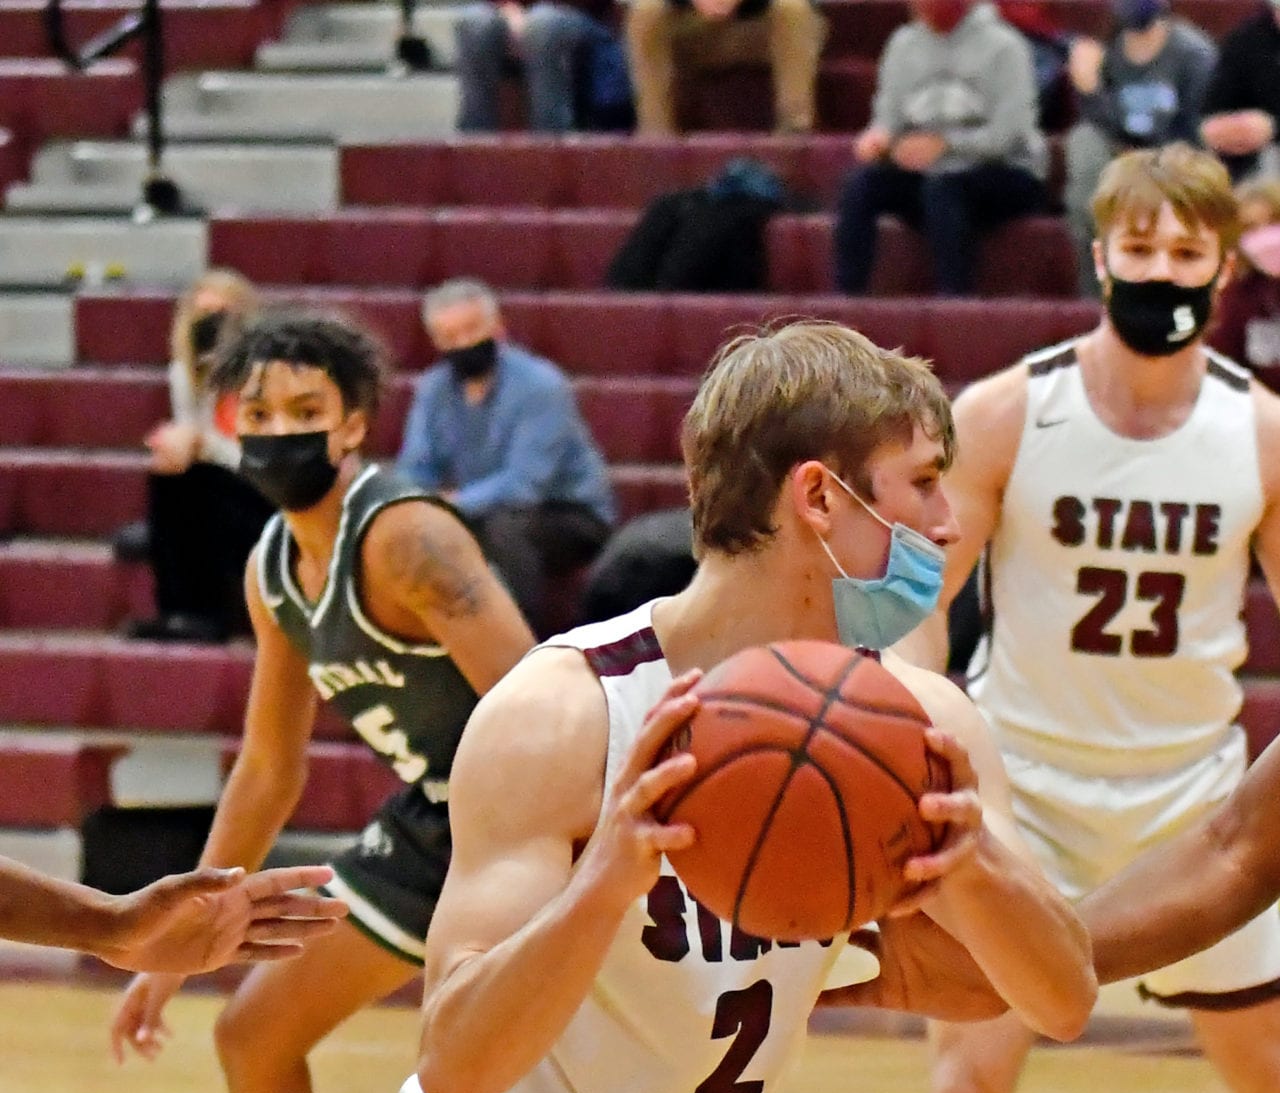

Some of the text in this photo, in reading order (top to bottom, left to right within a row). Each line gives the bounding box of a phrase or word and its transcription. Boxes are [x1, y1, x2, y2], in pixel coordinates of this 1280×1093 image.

[1052, 496, 1221, 555] STATE
[1071, 566, 1185, 657] 23
[352, 705, 428, 783] 5
